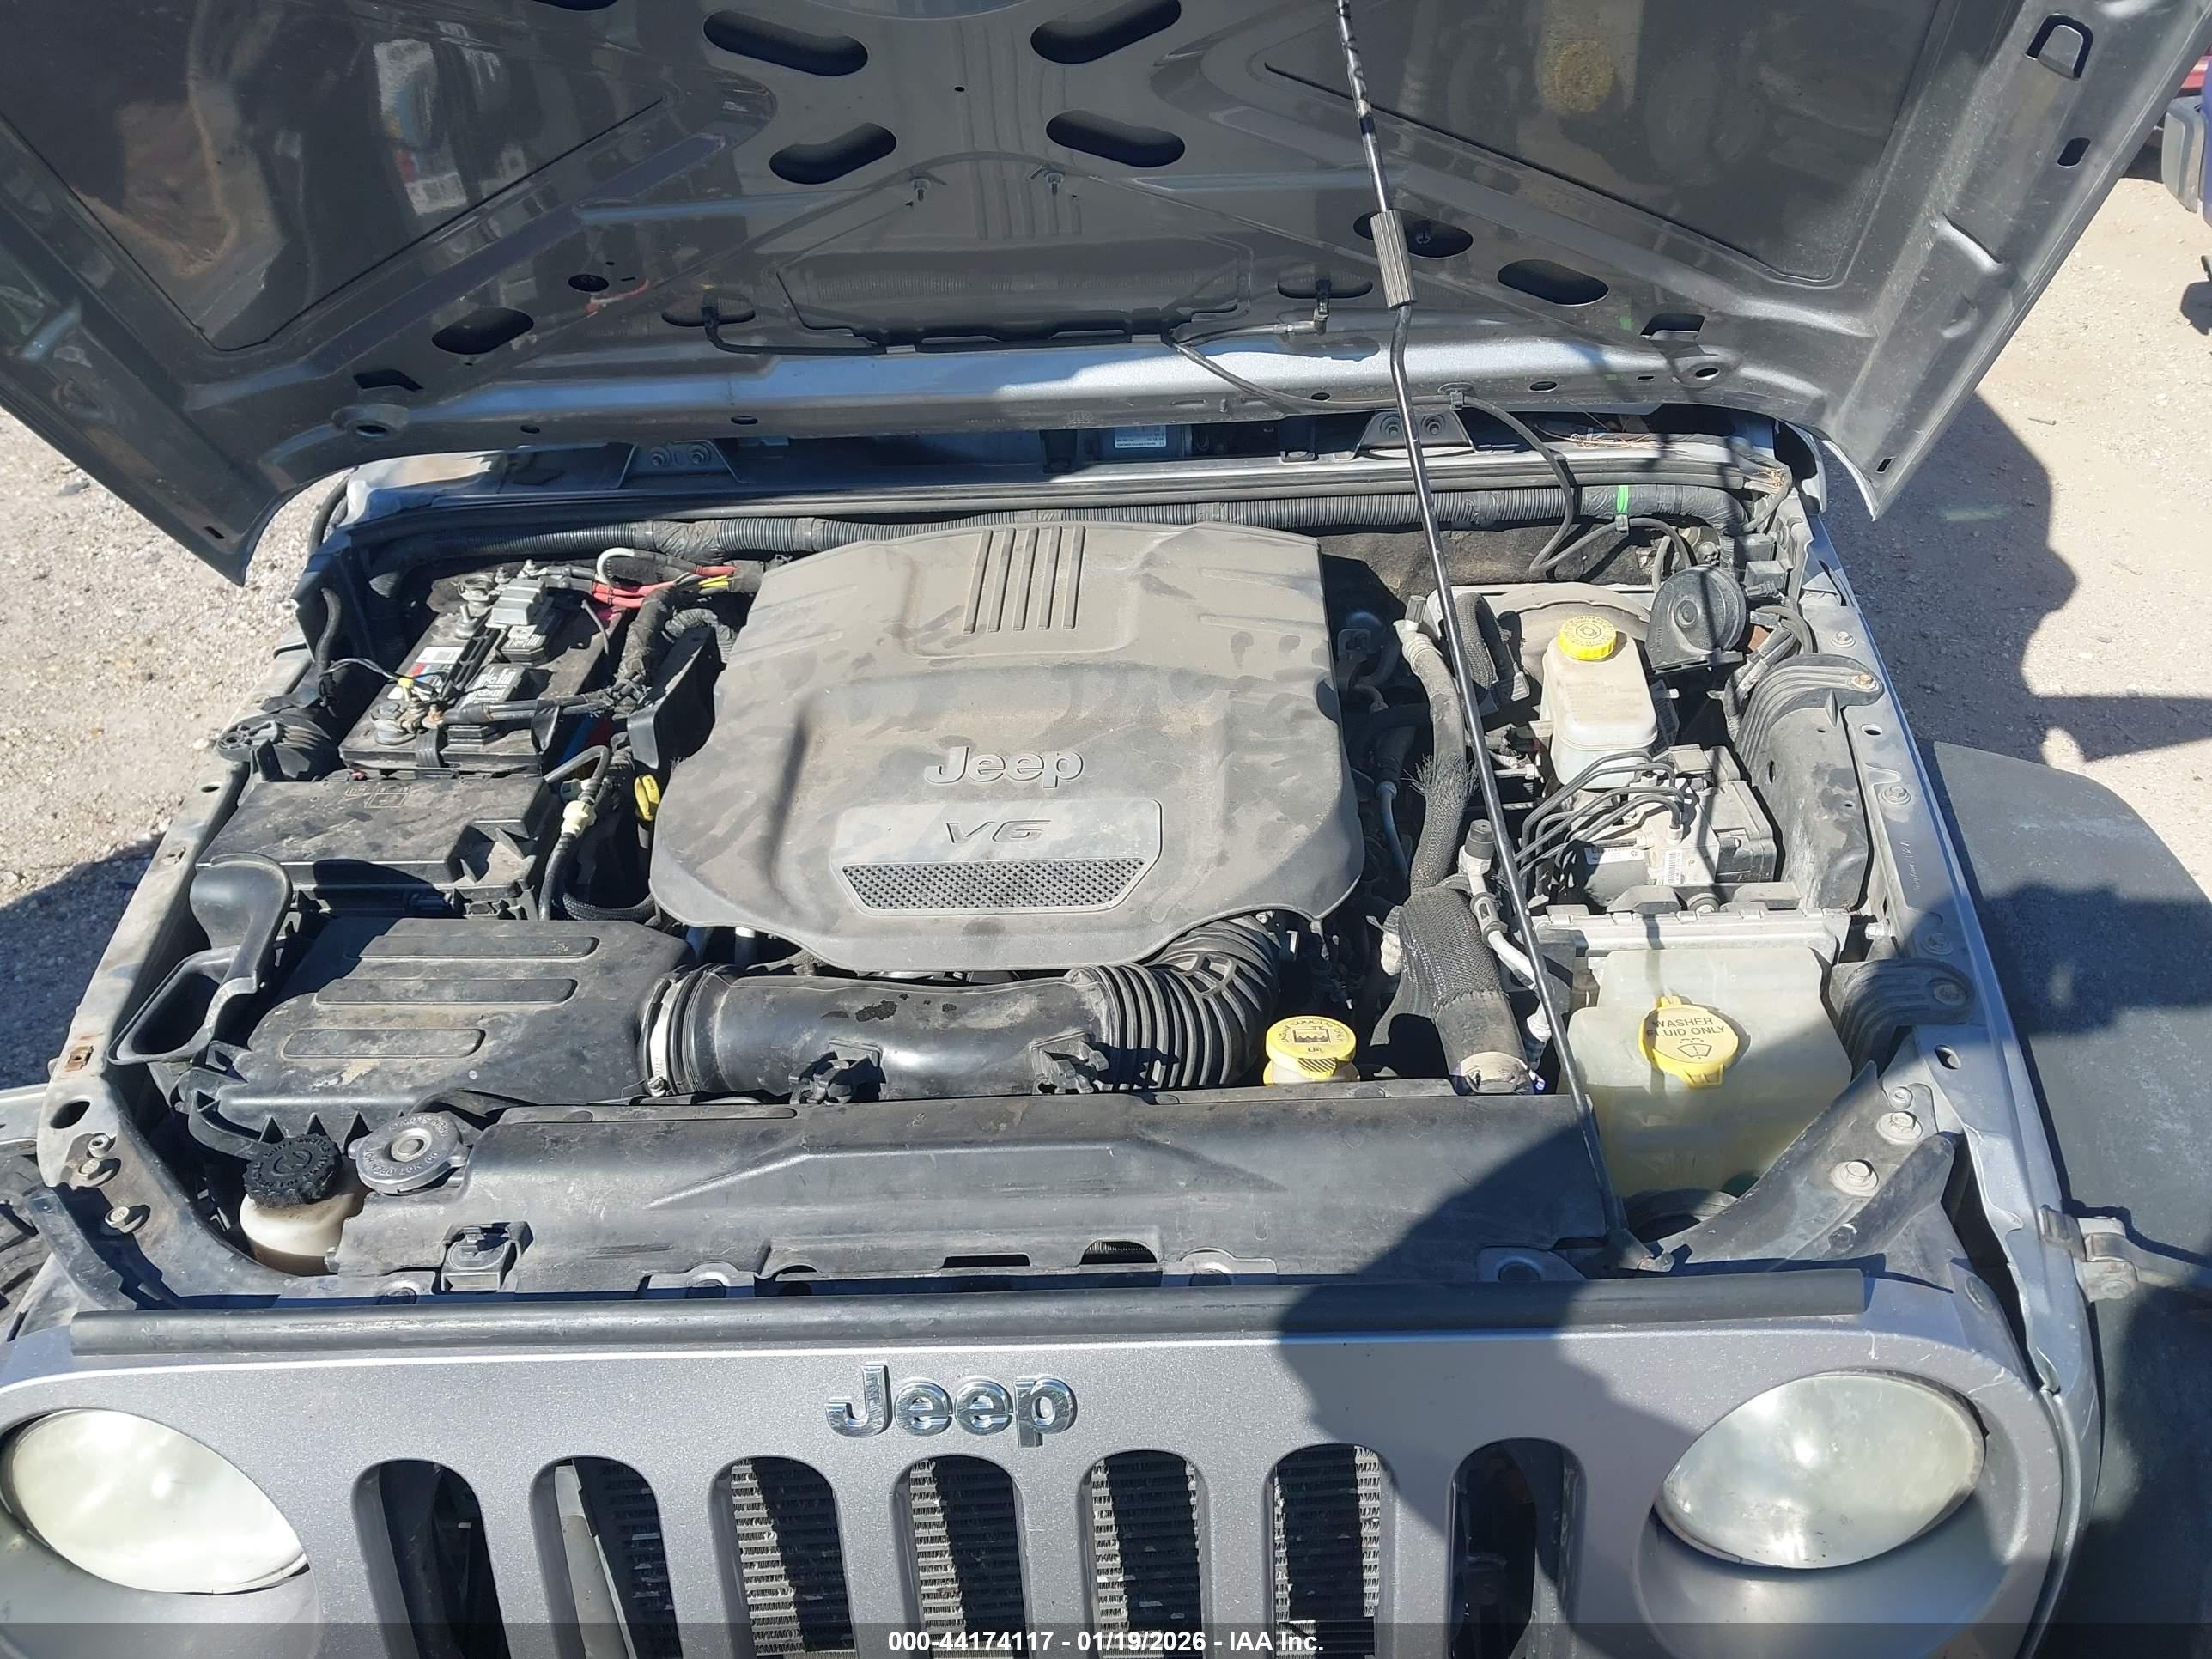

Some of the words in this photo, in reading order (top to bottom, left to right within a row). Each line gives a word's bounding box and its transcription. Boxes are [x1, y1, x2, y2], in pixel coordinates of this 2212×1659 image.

[924, 746, 1084, 789] Jeep
[946, 819, 1052, 844] V6
[1652, 1017, 1713, 1028] WASHER
[1646, 1028, 1686, 1037] FLUID
[1690, 1025, 1725, 1036] ONLY
[424, 1151, 440, 1164] DO
[371, 1162, 396, 1176] OPEN
[398, 1162, 422, 1176] NOT
[825, 1361, 1078, 1449] Jeep
